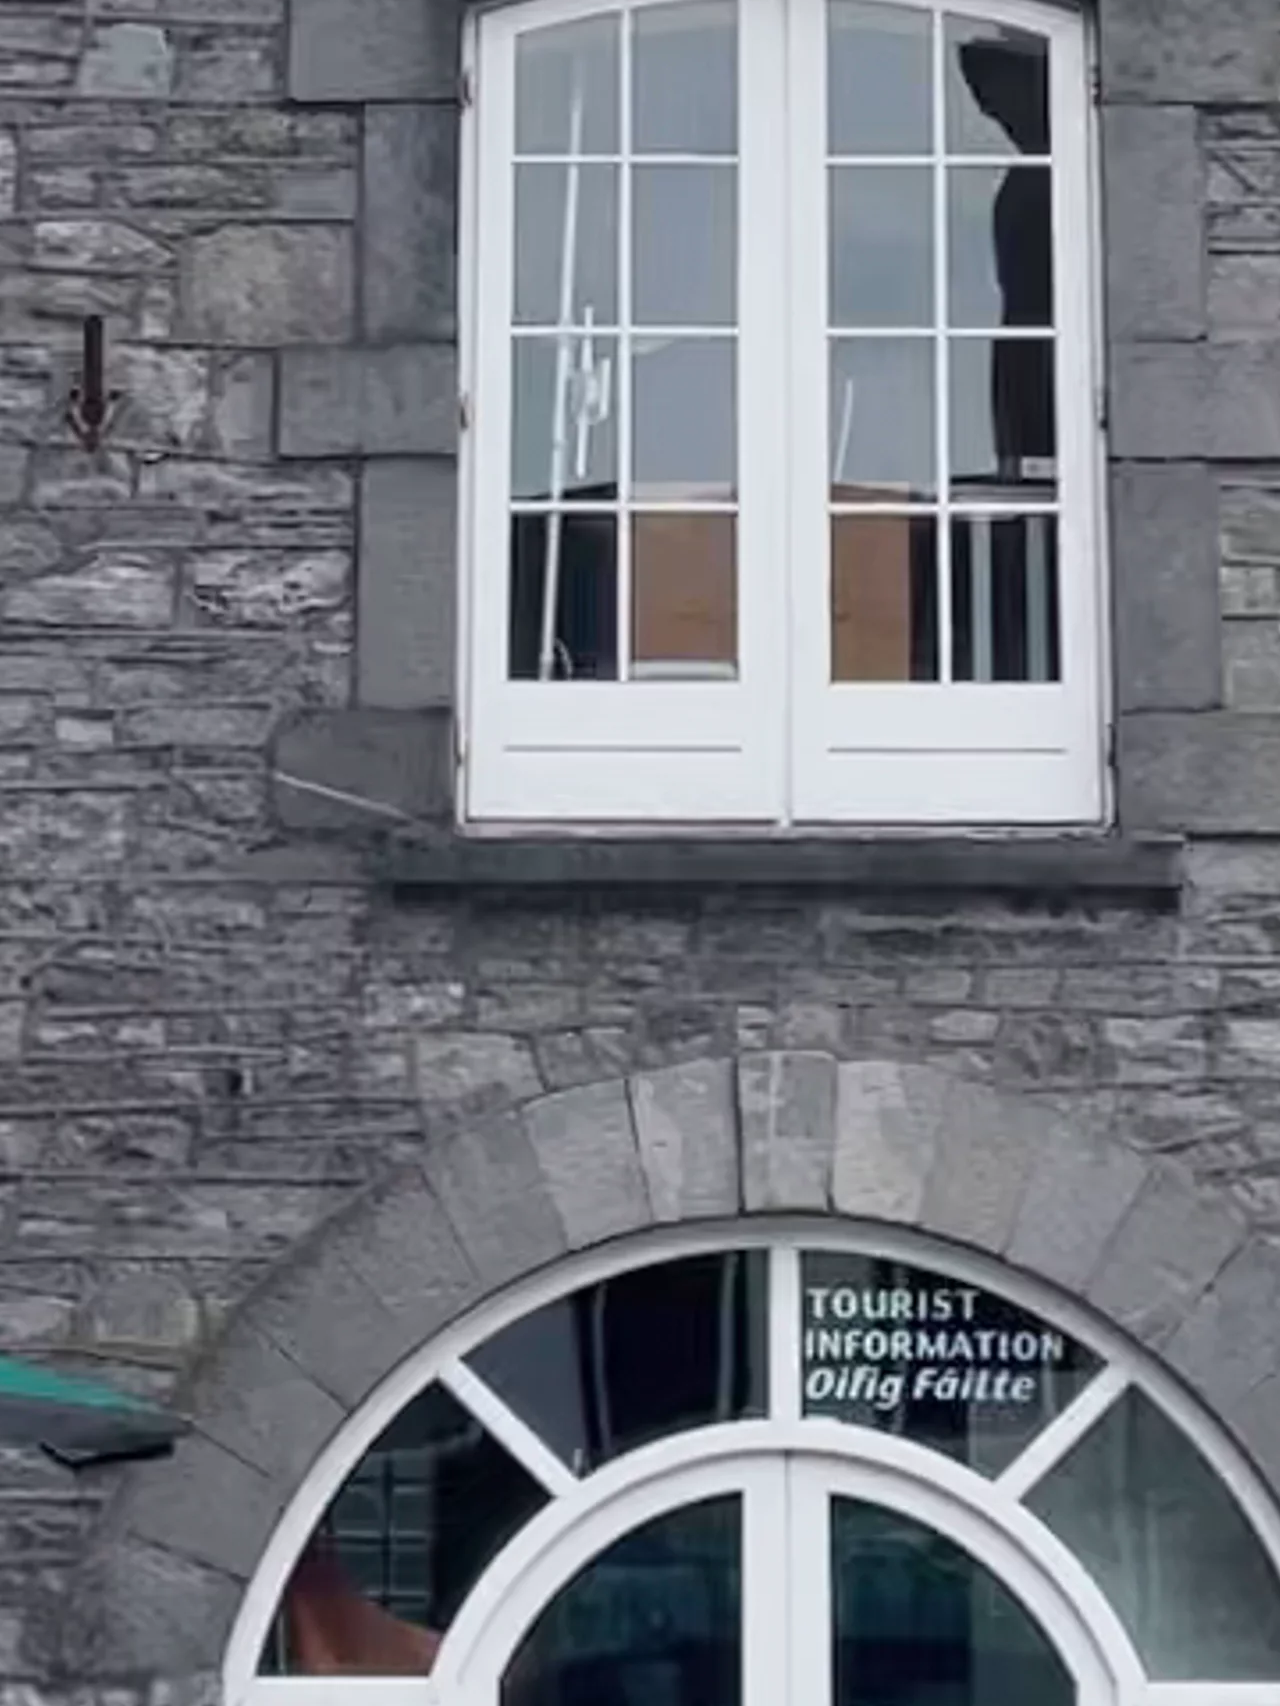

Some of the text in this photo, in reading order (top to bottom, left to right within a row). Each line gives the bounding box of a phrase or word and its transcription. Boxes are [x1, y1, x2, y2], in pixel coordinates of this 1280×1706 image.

[806, 1287, 980, 1321] TOURIST
[804, 1329, 1064, 1362] INFORMATION
[805, 1365, 905, 1411] Oifig
